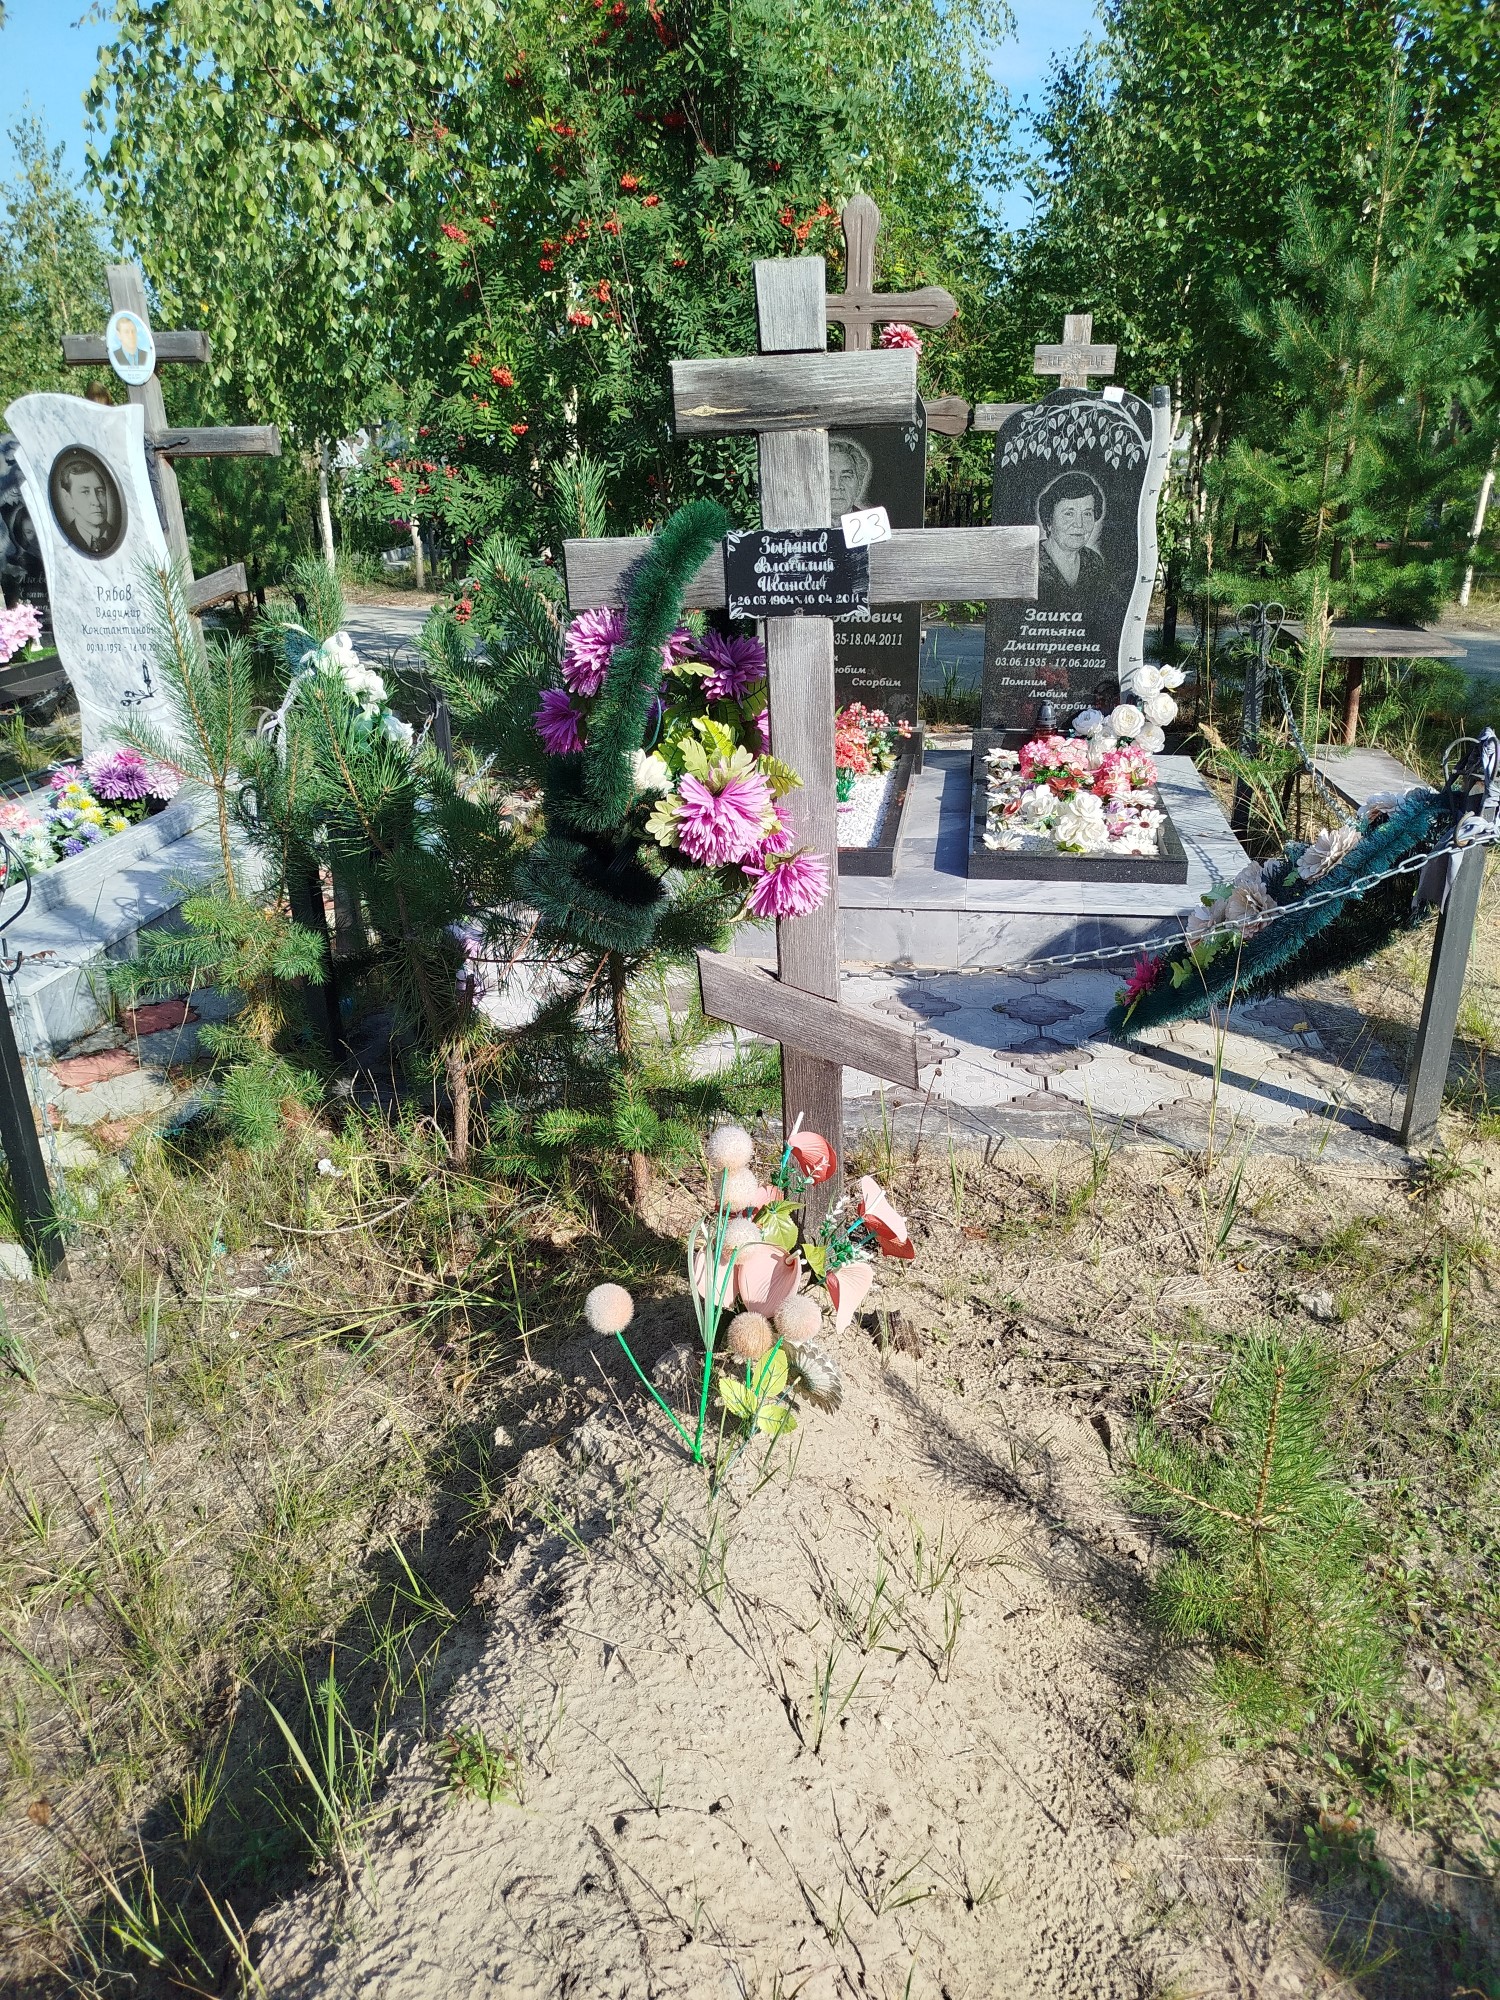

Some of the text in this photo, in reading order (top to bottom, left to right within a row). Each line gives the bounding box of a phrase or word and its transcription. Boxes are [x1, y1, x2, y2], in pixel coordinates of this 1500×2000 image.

[849, 513, 886, 544] 23
[758, 531, 828, 557] Зырянов
[757, 573, 827, 592] Иванович
[96, 583, 132, 602] Рябов
[95, 606, 141, 621] Владимир
[1024, 608, 1083, 622] Заика
[1020, 625, 1086, 637] Татьяна
[86, 643, 122, 654] 09.11.1952
[1003, 640, 1101, 654] Дмитриевна
[834, 665, 866, 674] юбим
[995, 657, 1047, 667] 03.06.1935
[1055, 658, 1107, 669] 17.06.2022
[851, 677, 902, 688] Скорбим
[1000, 677, 1047, 686] Помним
[1028, 688, 1068, 698] Любим
